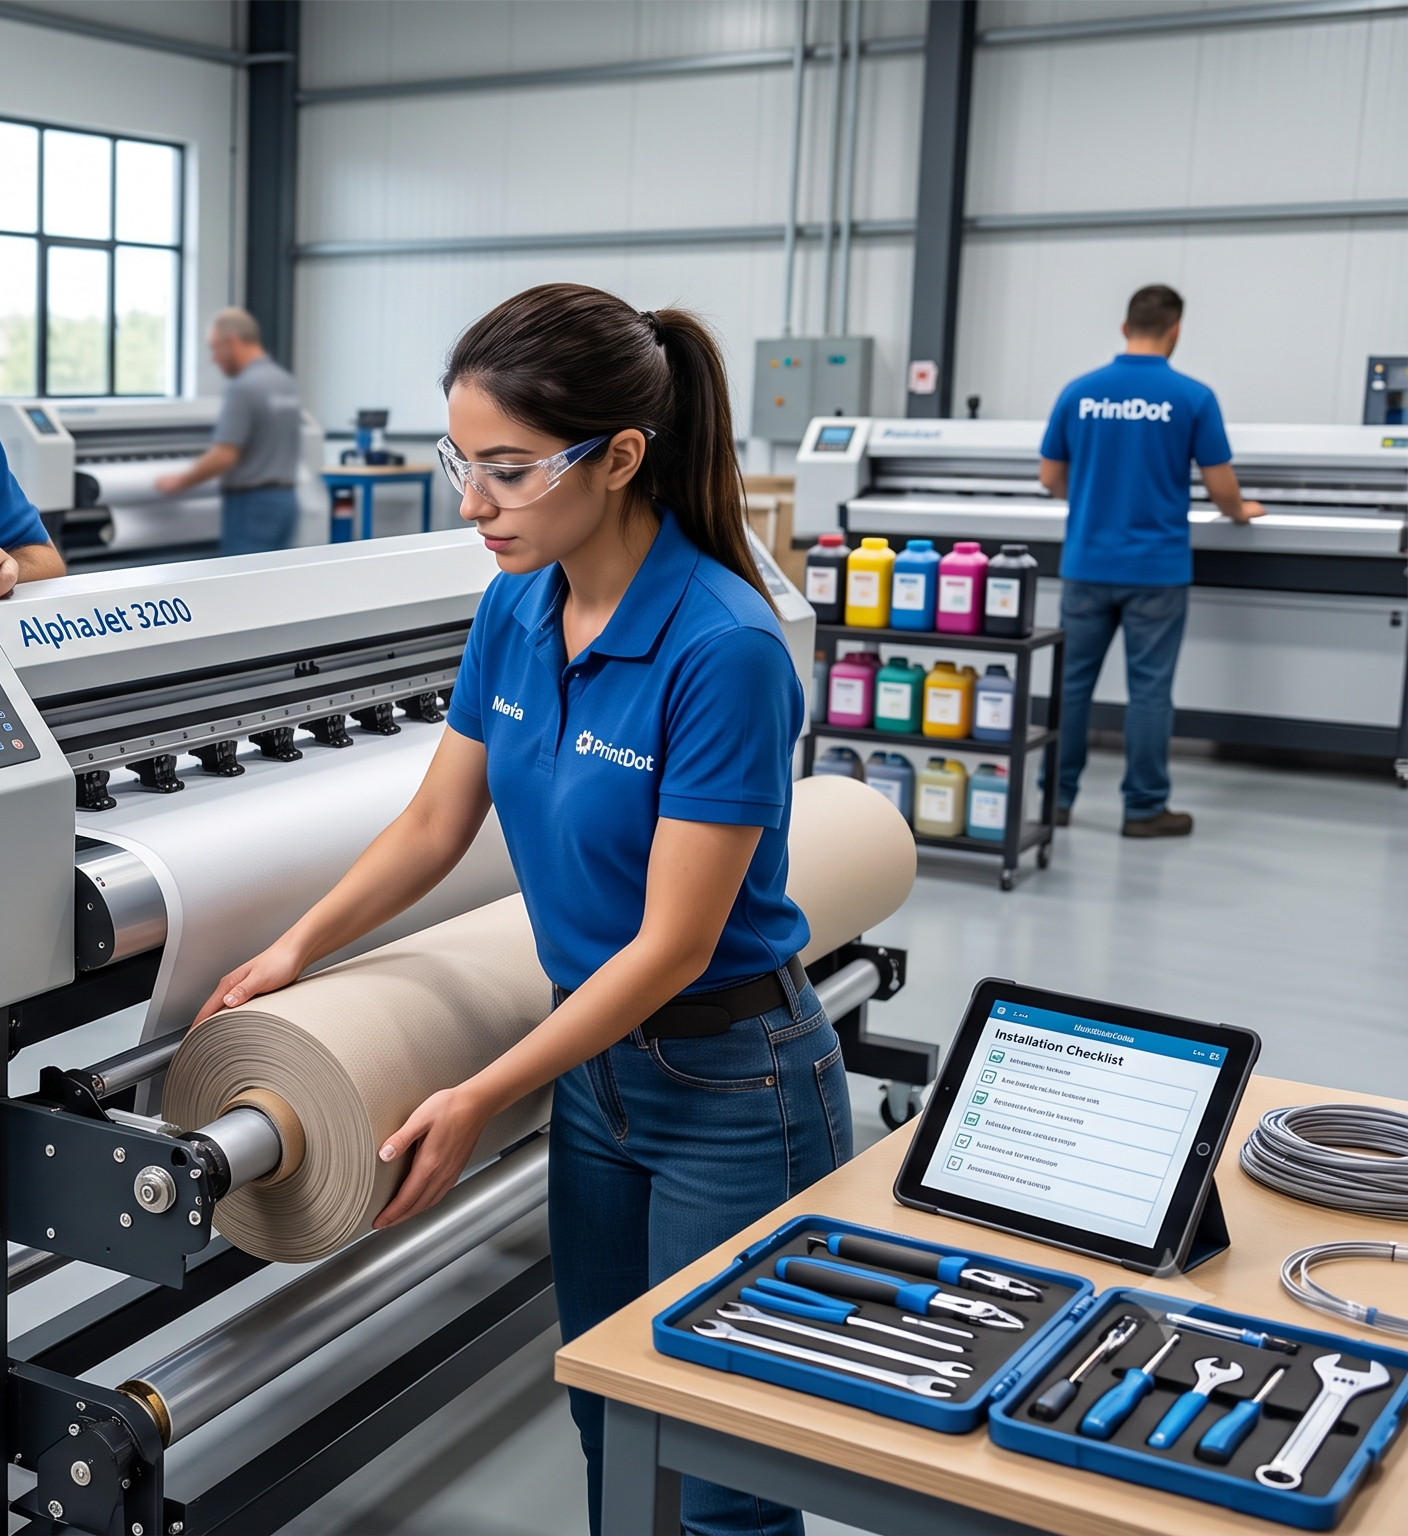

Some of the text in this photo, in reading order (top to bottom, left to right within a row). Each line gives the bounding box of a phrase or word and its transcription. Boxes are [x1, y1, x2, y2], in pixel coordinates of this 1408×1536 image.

[1079, 397, 1173, 422] PrintDot
[19, 597, 192, 649] AlphaJet 3200
[592, 739, 655, 772] PrintDot
[995, 1028, 1063, 1053] Installation
[1066, 1045, 1124, 1067] Checklist
